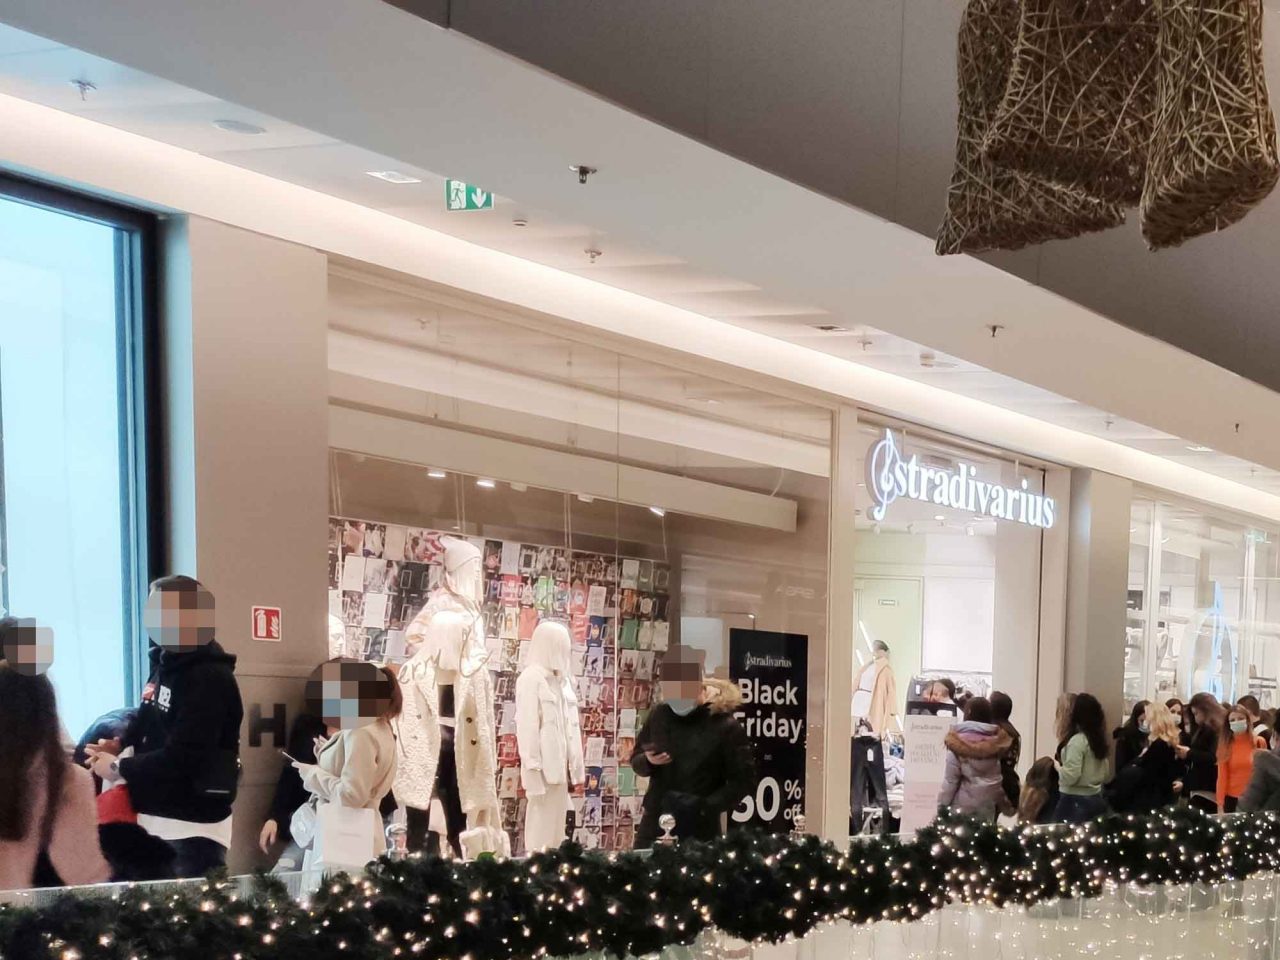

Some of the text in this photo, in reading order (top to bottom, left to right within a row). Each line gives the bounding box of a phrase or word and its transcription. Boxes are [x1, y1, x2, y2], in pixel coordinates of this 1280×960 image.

[893, 453, 1056, 529] stradivarius
[397, 648, 442, 690] erry
[749, 653, 793, 668] stradivarius
[738, 678, 799, 705] Black
